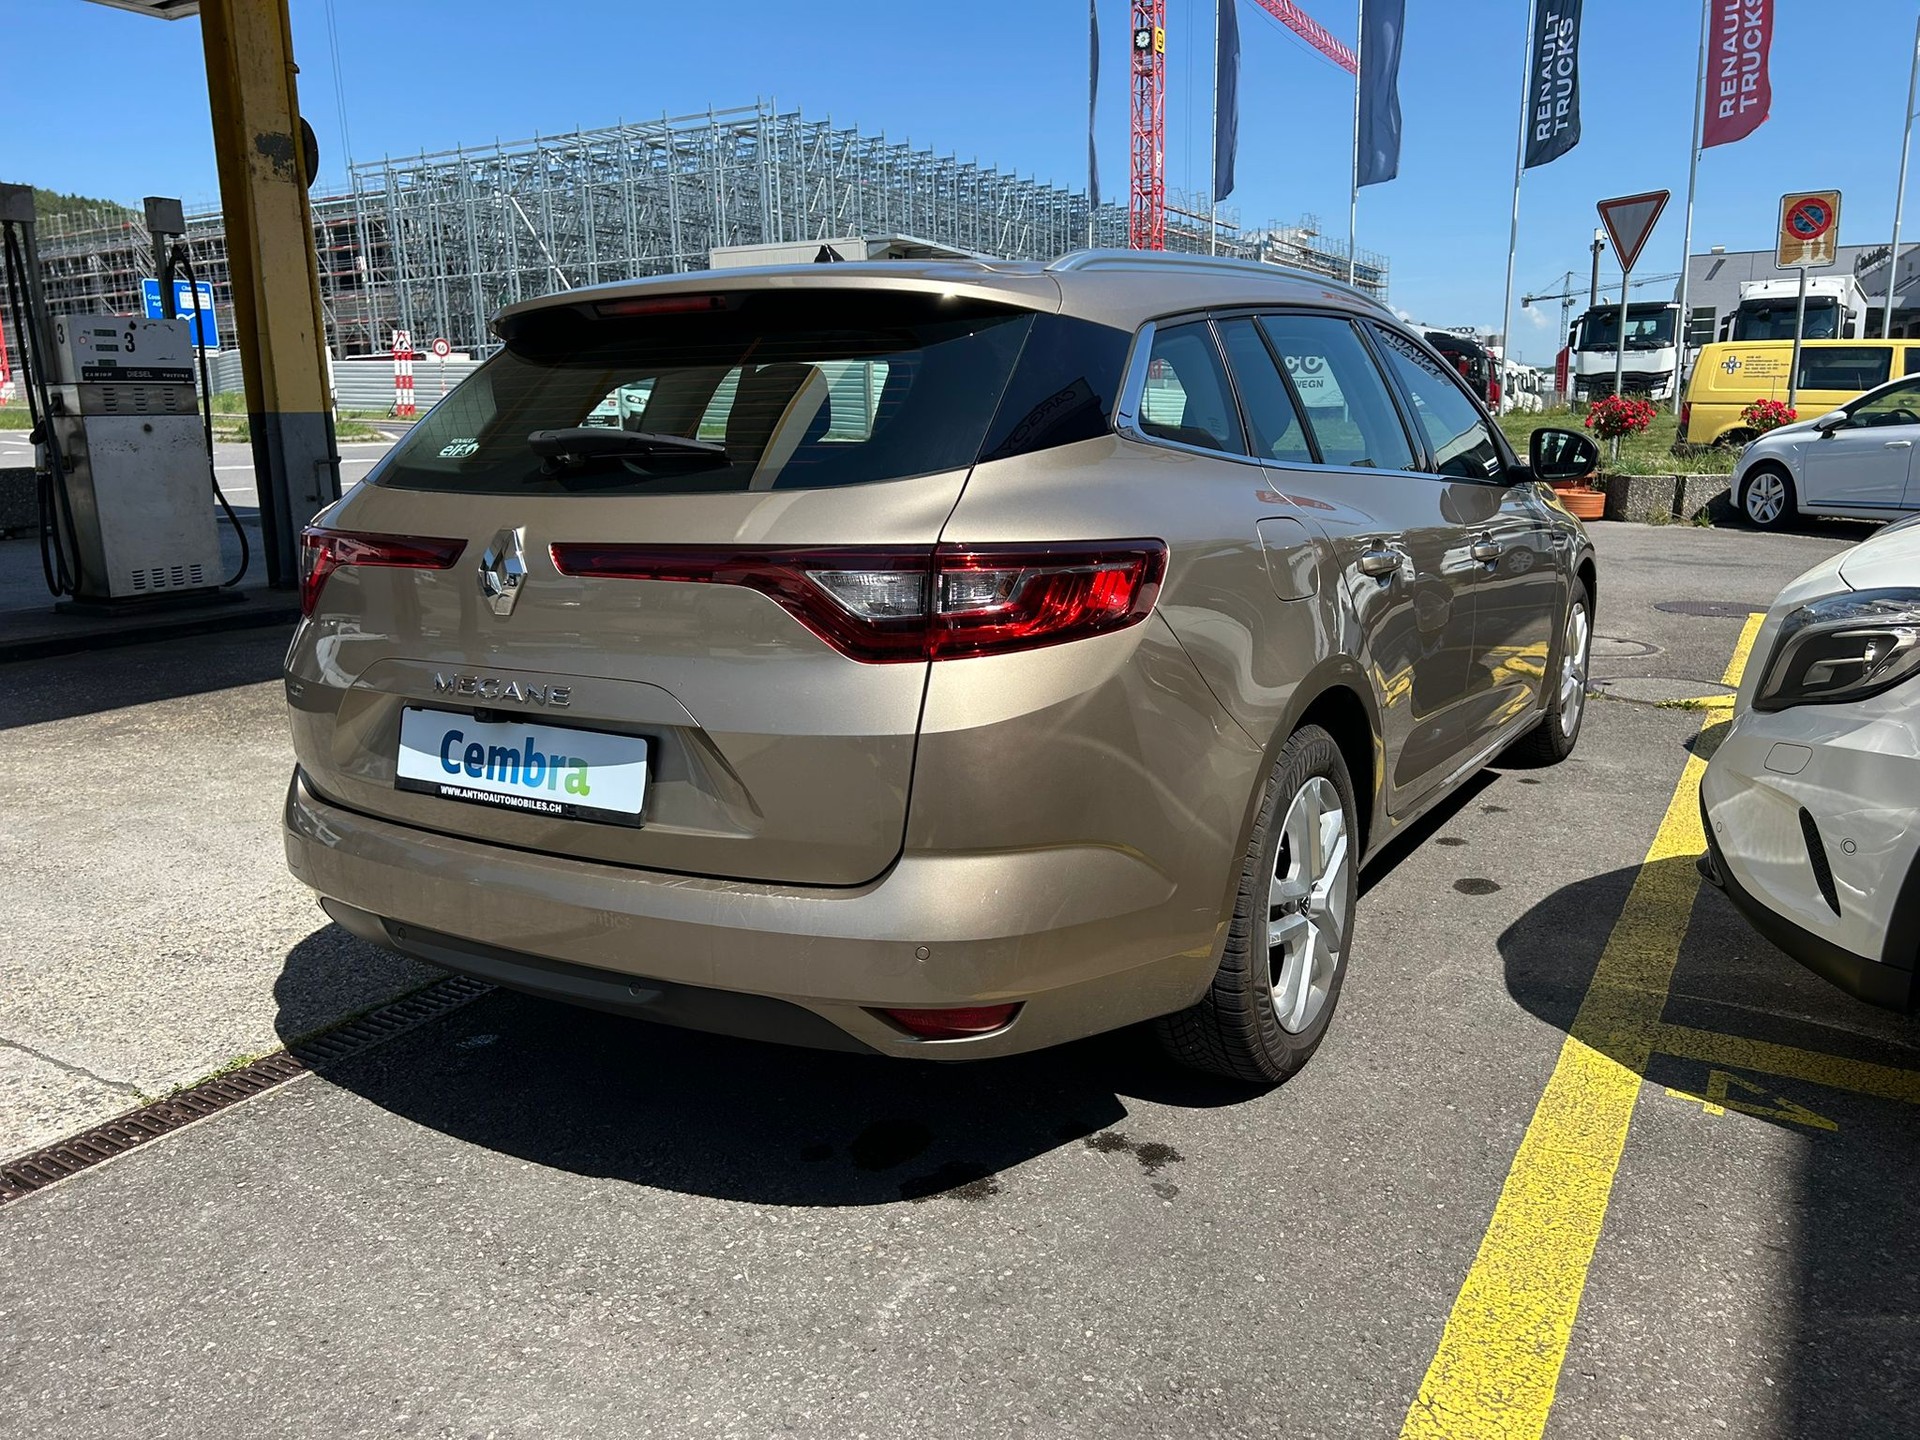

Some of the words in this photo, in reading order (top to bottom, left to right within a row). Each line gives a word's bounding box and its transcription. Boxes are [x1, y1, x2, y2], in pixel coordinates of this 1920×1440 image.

[1537, 12, 1559, 141] RENAULT
[1554, 17, 1575, 136] TRUCKS
[1719, 0, 1741, 119] RENAUL
[57, 324, 65, 344] 3
[124, 332, 136, 352] 3
[434, 672, 571, 706] MEGANE
[440, 729, 590, 797] Cembra
[440, 785, 562, 813] WWW.ANTHOAUTOMOBILES.CH
